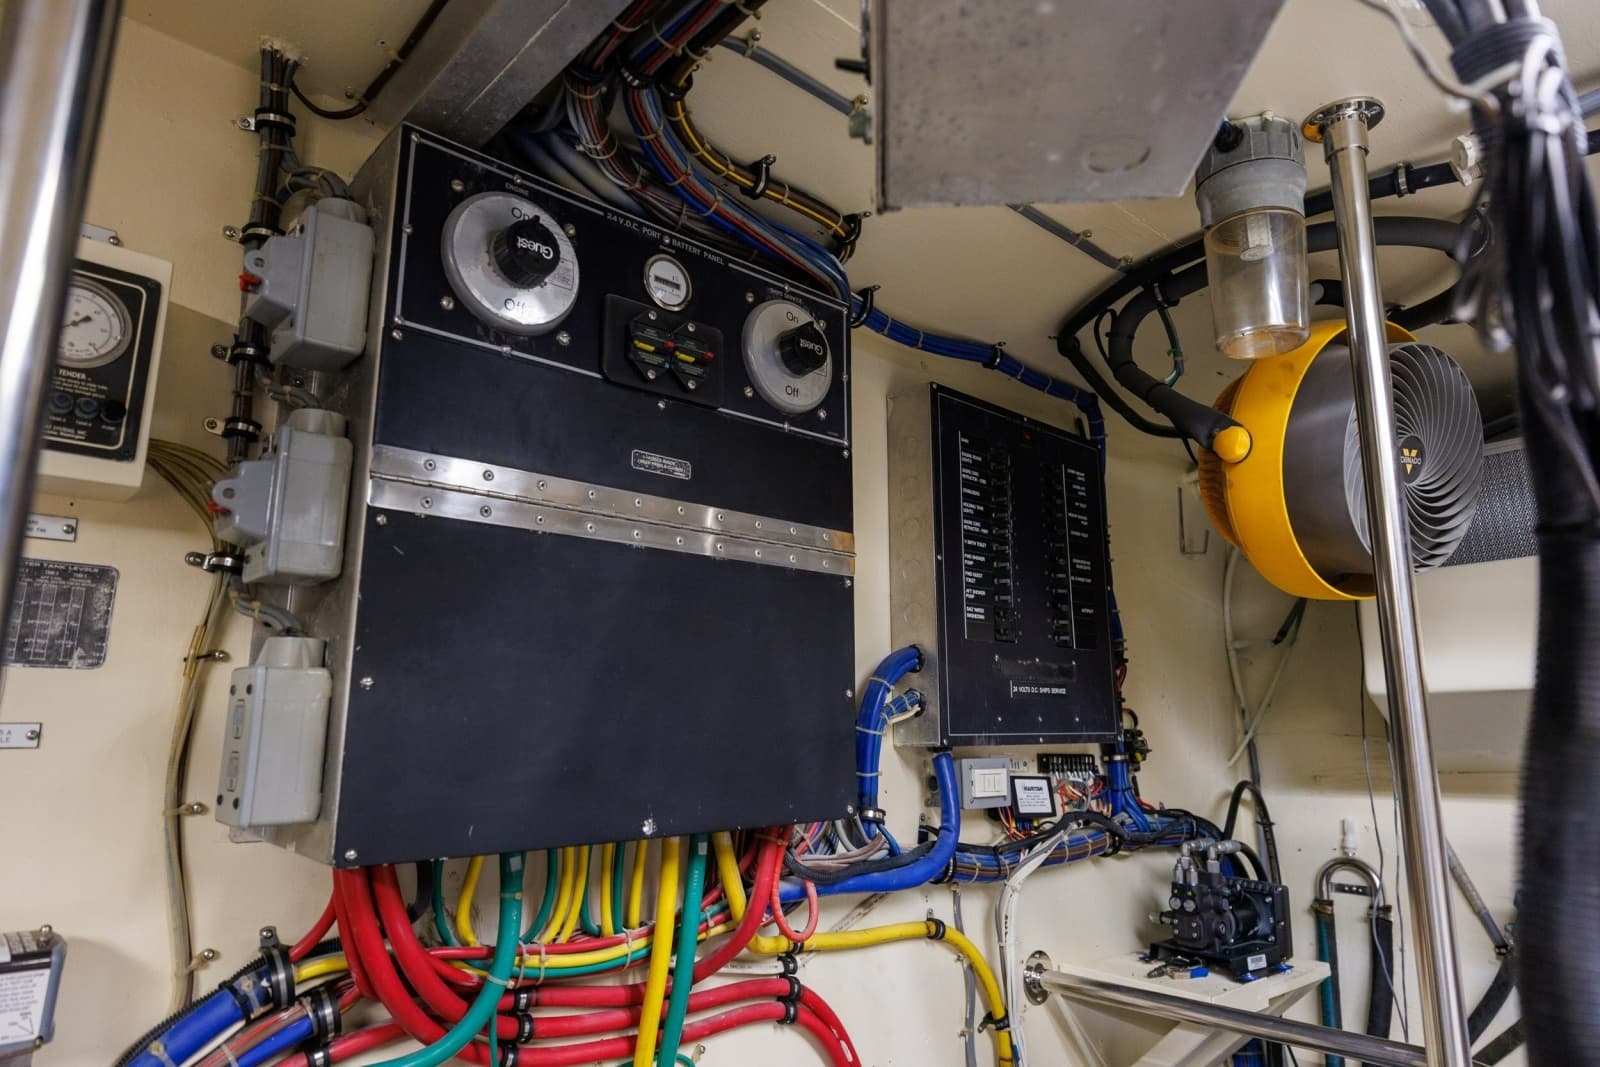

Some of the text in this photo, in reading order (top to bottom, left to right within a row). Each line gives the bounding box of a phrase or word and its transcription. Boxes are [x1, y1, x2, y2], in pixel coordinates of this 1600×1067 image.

[511, 206, 530, 221] On
[517, 236, 554, 260] Guest
[672, 239, 701, 256] BATTERY
[703, 251, 724, 265] PANEL
[504, 297, 526, 311] Off
[786, 311, 799, 324] On
[800, 338, 823, 356] Guest
[785, 384, 799, 398] Off
